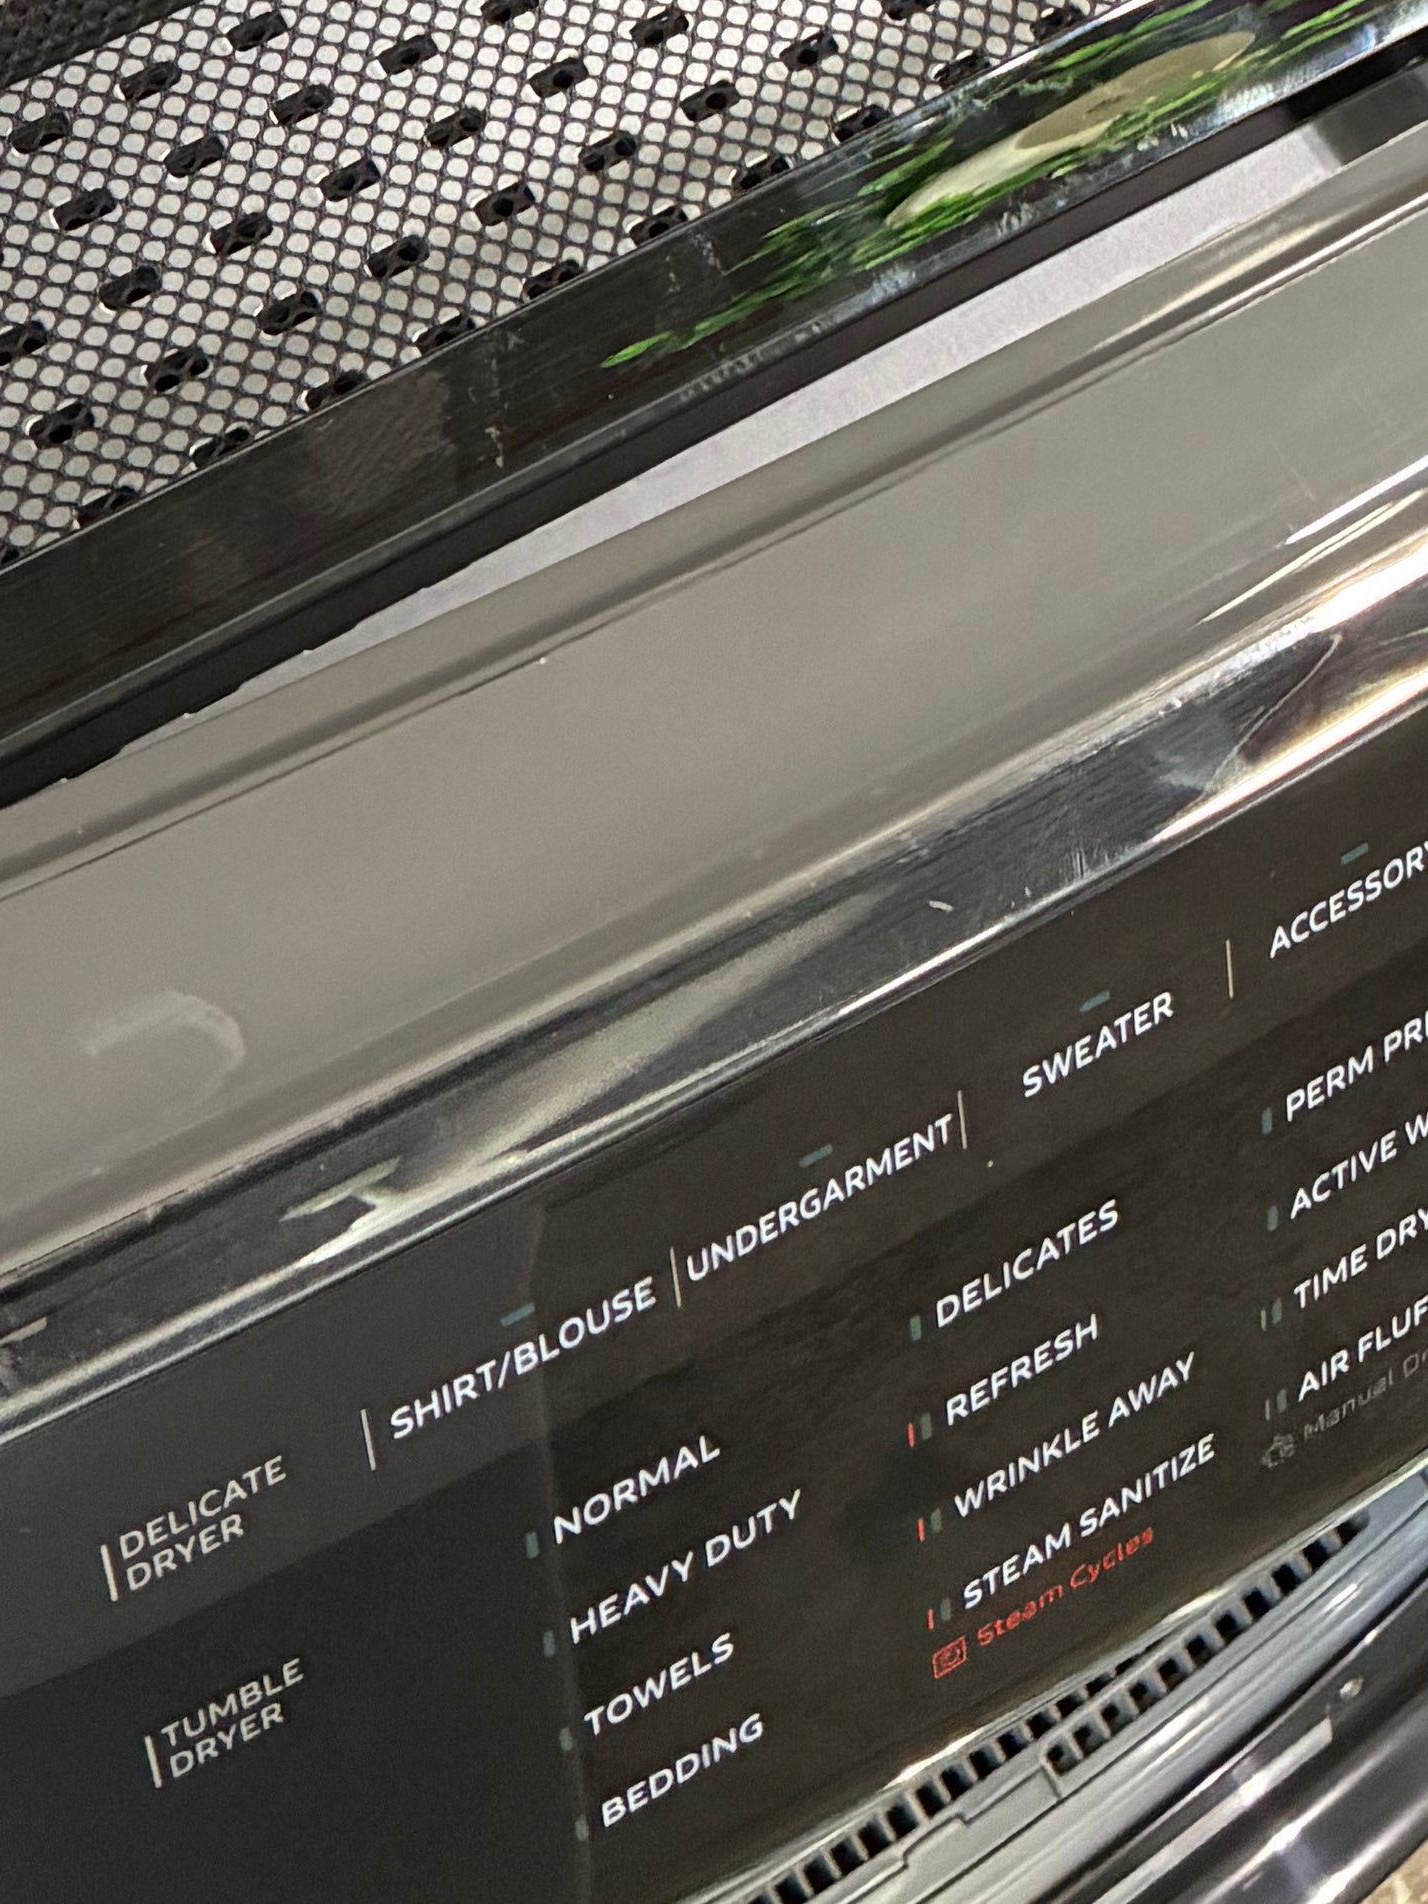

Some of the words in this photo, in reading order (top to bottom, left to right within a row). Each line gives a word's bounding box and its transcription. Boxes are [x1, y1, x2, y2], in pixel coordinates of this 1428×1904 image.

[1021, 990, 1175, 1099] SWEATER
[1285, 1044, 1375, 1123] PERM
[685, 1112, 954, 1284] UNDERGARMENT
[1289, 1129, 1398, 1221] ACTIVE
[935, 1198, 1120, 1329] DELICATES
[1292, 1243, 1369, 1310] TIME
[389, 1275, 657, 1441] SHIRT/BLOUSE
[945, 1312, 1100, 1427] REFRESH
[1297, 1348, 1351, 1403] AIR
[1303, 1366, 1394, 1442] Manual
[552, 1434, 721, 1545] NORMAL
[954, 1409, 1101, 1519] WRINKLE
[1107, 1351, 1196, 1430] AWAY
[118, 1454, 287, 1561] DELICATE
[125, 1513, 245, 1592] DRYER
[962, 1522, 1072, 1611] STEAM
[1078, 1432, 1216, 1539] SANITIZE
[569, 1549, 695, 1646] HEAVY
[704, 1487, 802, 1568] DUTY
[977, 1583, 1064, 1648] Steam
[1068, 1525, 1155, 1591] Cycles
[160, 1656, 305, 1748] TUMBLE
[583, 1631, 735, 1738] TOWELS
[168, 1701, 286, 1780] DRYER
[600, 1711, 765, 1829] BEDDING
